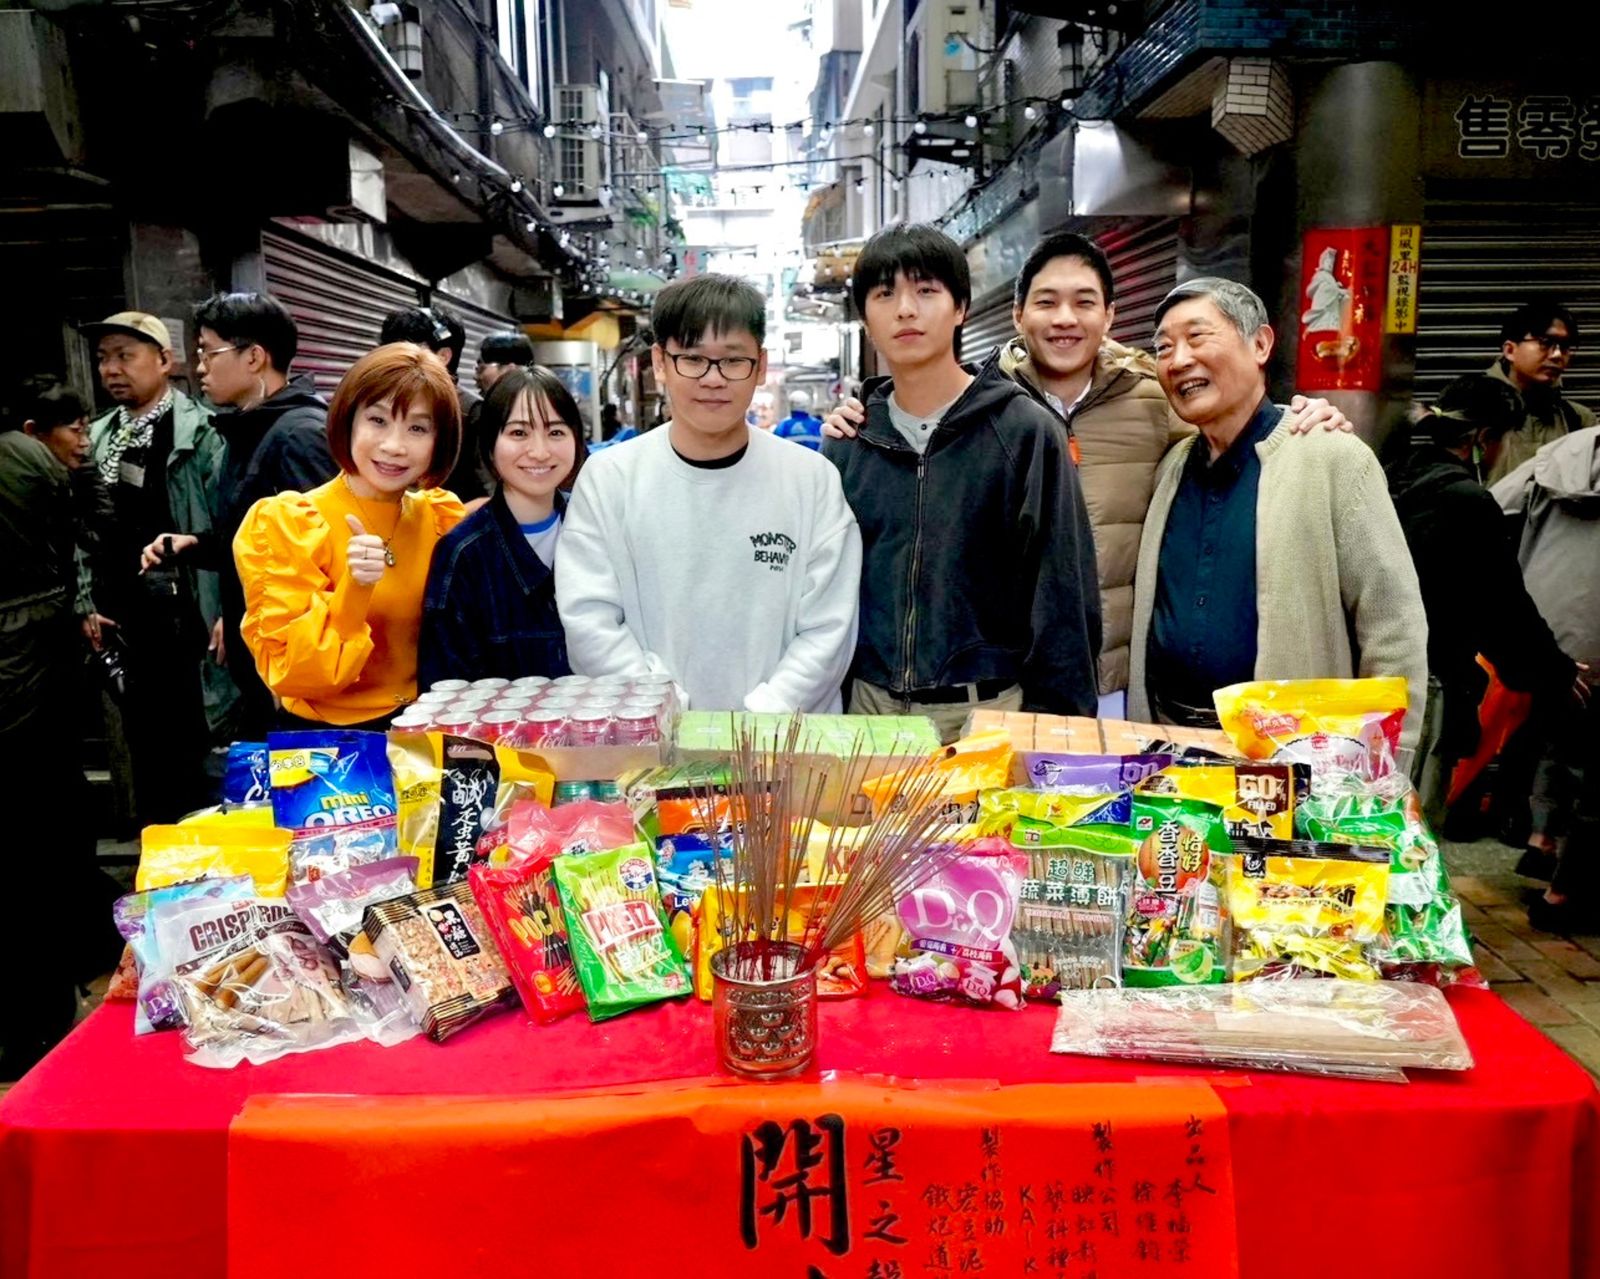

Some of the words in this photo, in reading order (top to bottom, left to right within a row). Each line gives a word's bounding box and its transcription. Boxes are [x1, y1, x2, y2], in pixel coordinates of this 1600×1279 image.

[320, 791, 369, 810] mini
[1247, 801, 1276, 812] FILLED
[304, 803, 393, 828] OREO
[1048, 859, 1095, 882] 超鮮
[1155, 820, 1180, 895] 香香豆
[1020, 879, 1119, 907] 蔬菜薄餅
[508, 901, 568, 948] POCK
[912, 887, 1003, 942] Dr.Q
[740, 1113, 850, 1279] 開
